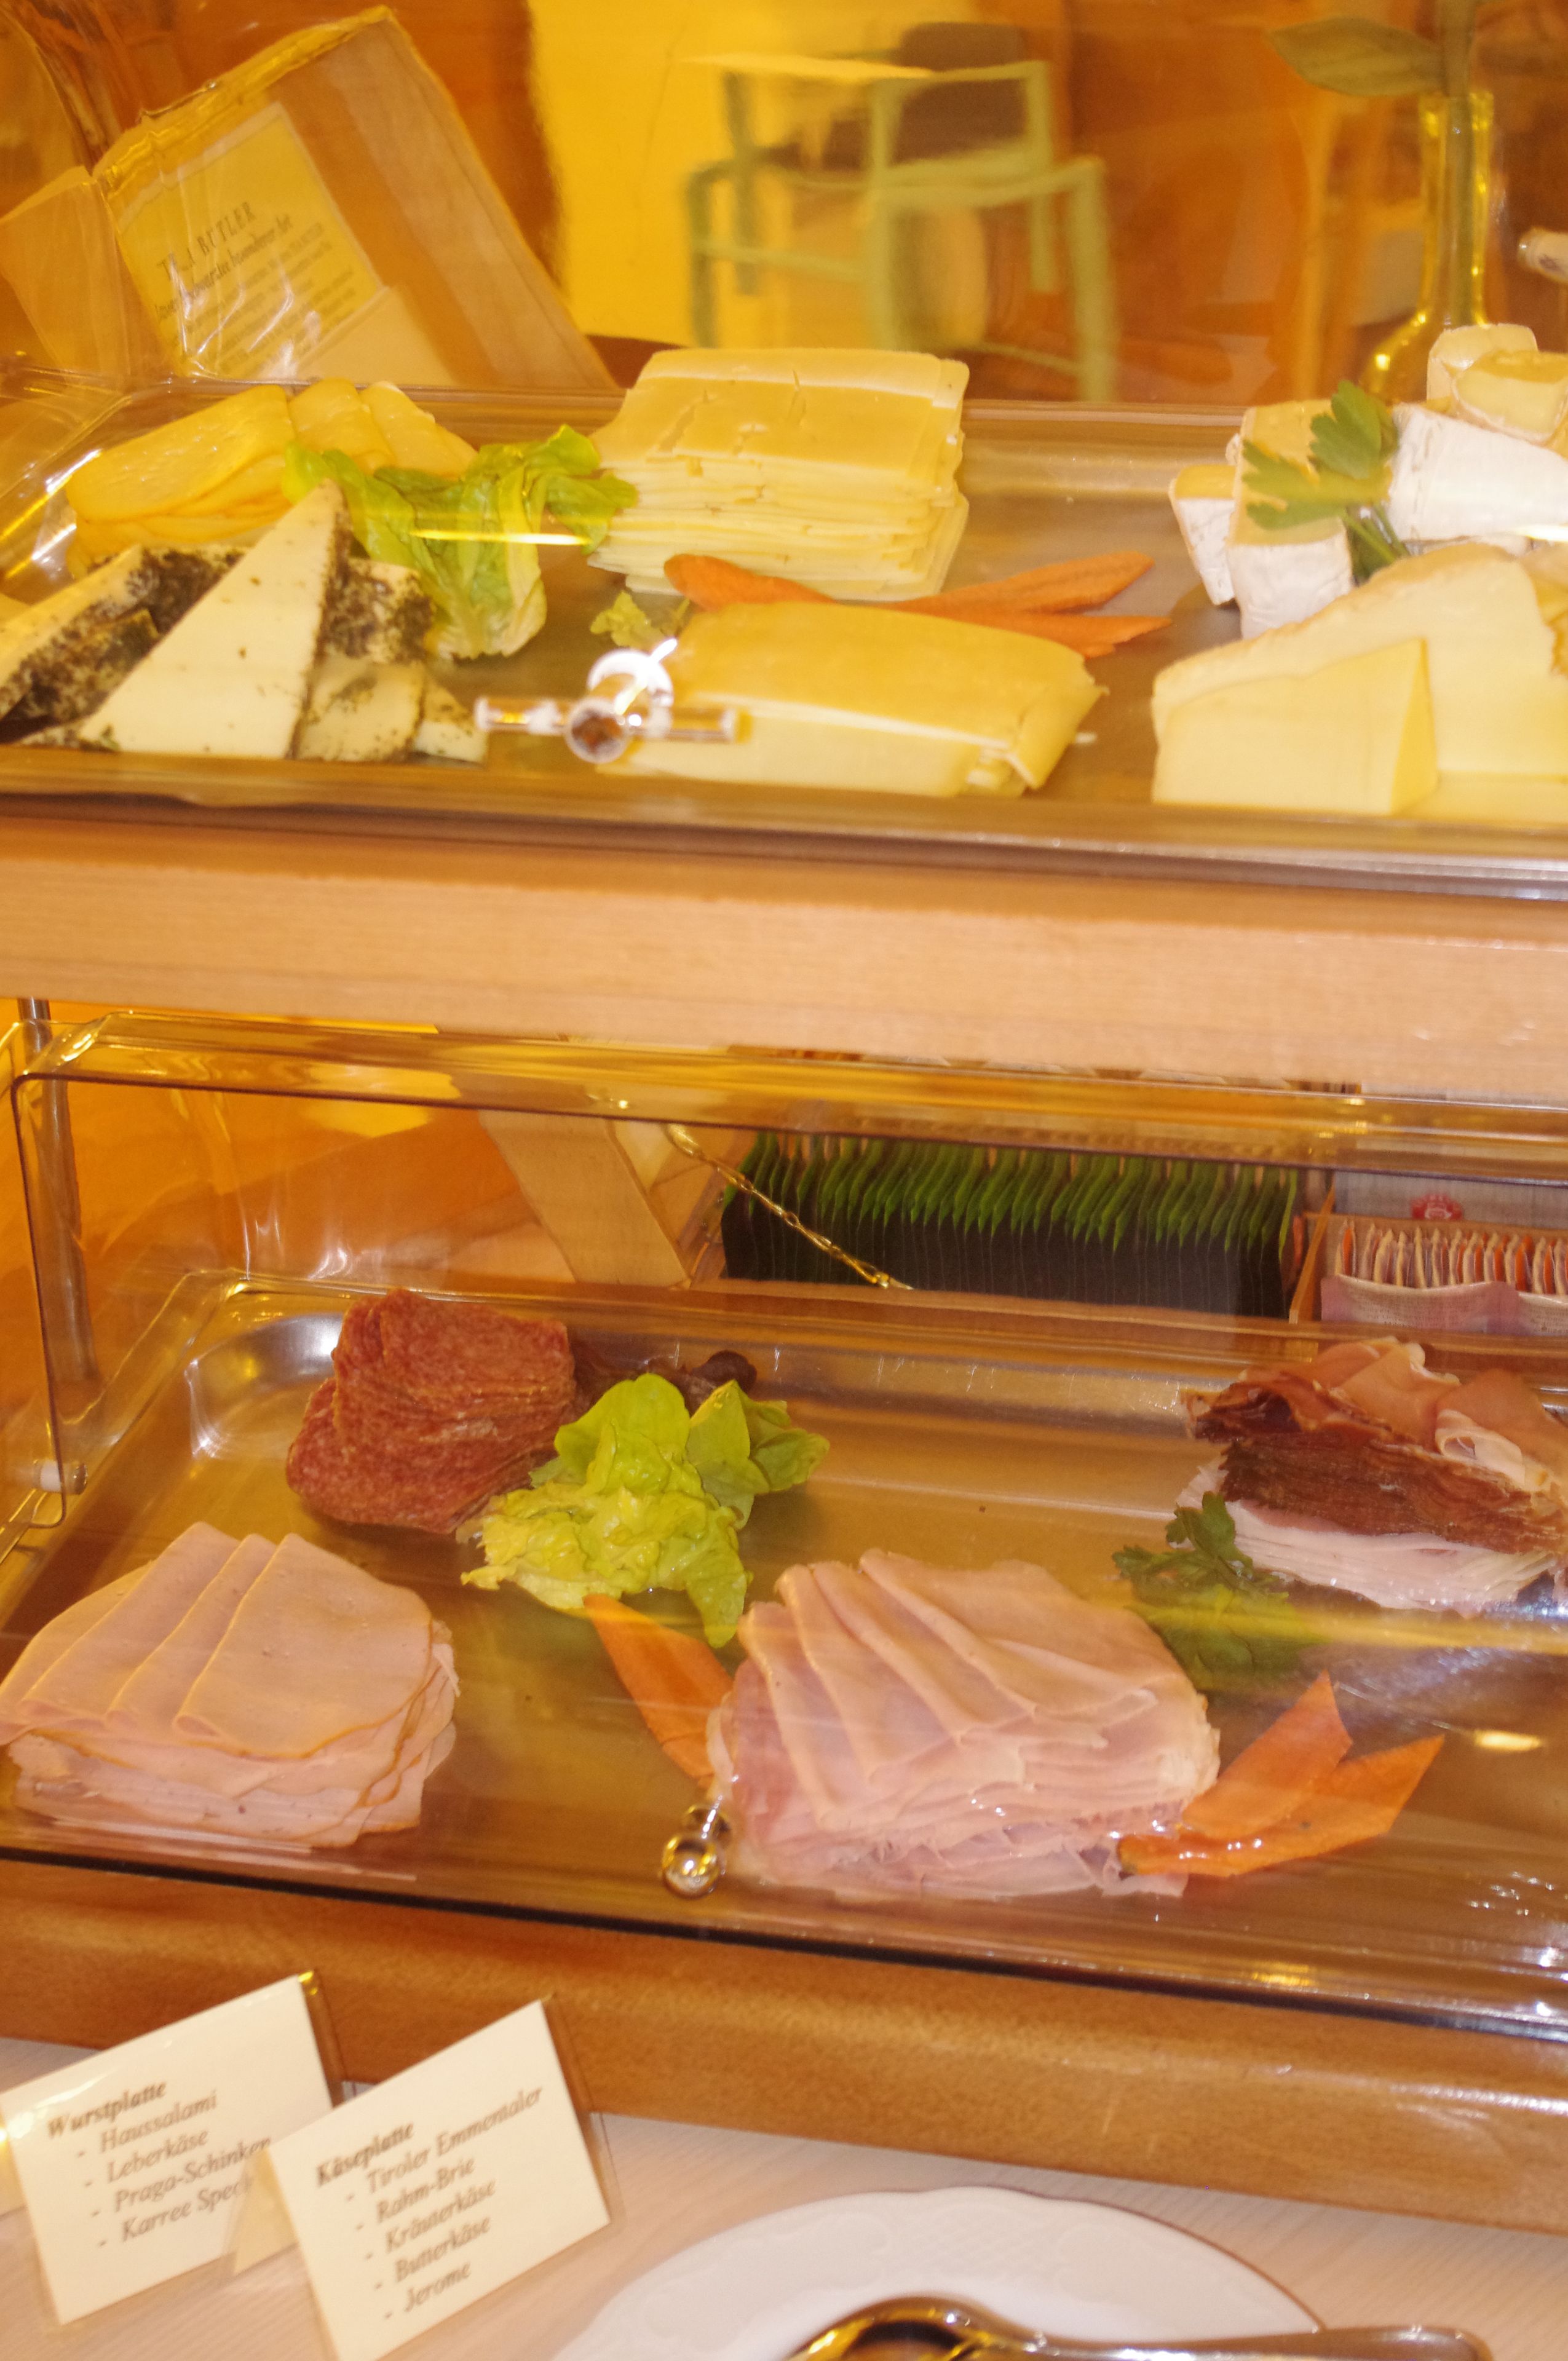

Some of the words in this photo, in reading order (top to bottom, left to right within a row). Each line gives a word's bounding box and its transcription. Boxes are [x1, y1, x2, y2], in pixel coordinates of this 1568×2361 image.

[47, 2081, 167, 2139] Wurstplatte
[99, 2090, 218, 2153] Haussalami
[366, 2148, 430, 2193] Tiroler
[435, 2087, 542, 2156] Emmentaler
[106, 2129, 208, 2183] Leberkäse
[316, 2122, 414, 2187] Käseplatte
[121, 2199, 192, 2242] Karree
[376, 2157, 475, 2223] Rahm-Brie
[385, 2179, 496, 2253] Kräuterkäse
[394, 2217, 490, 2282] Butterkäse
[404, 2262, 471, 2313] Jerome
